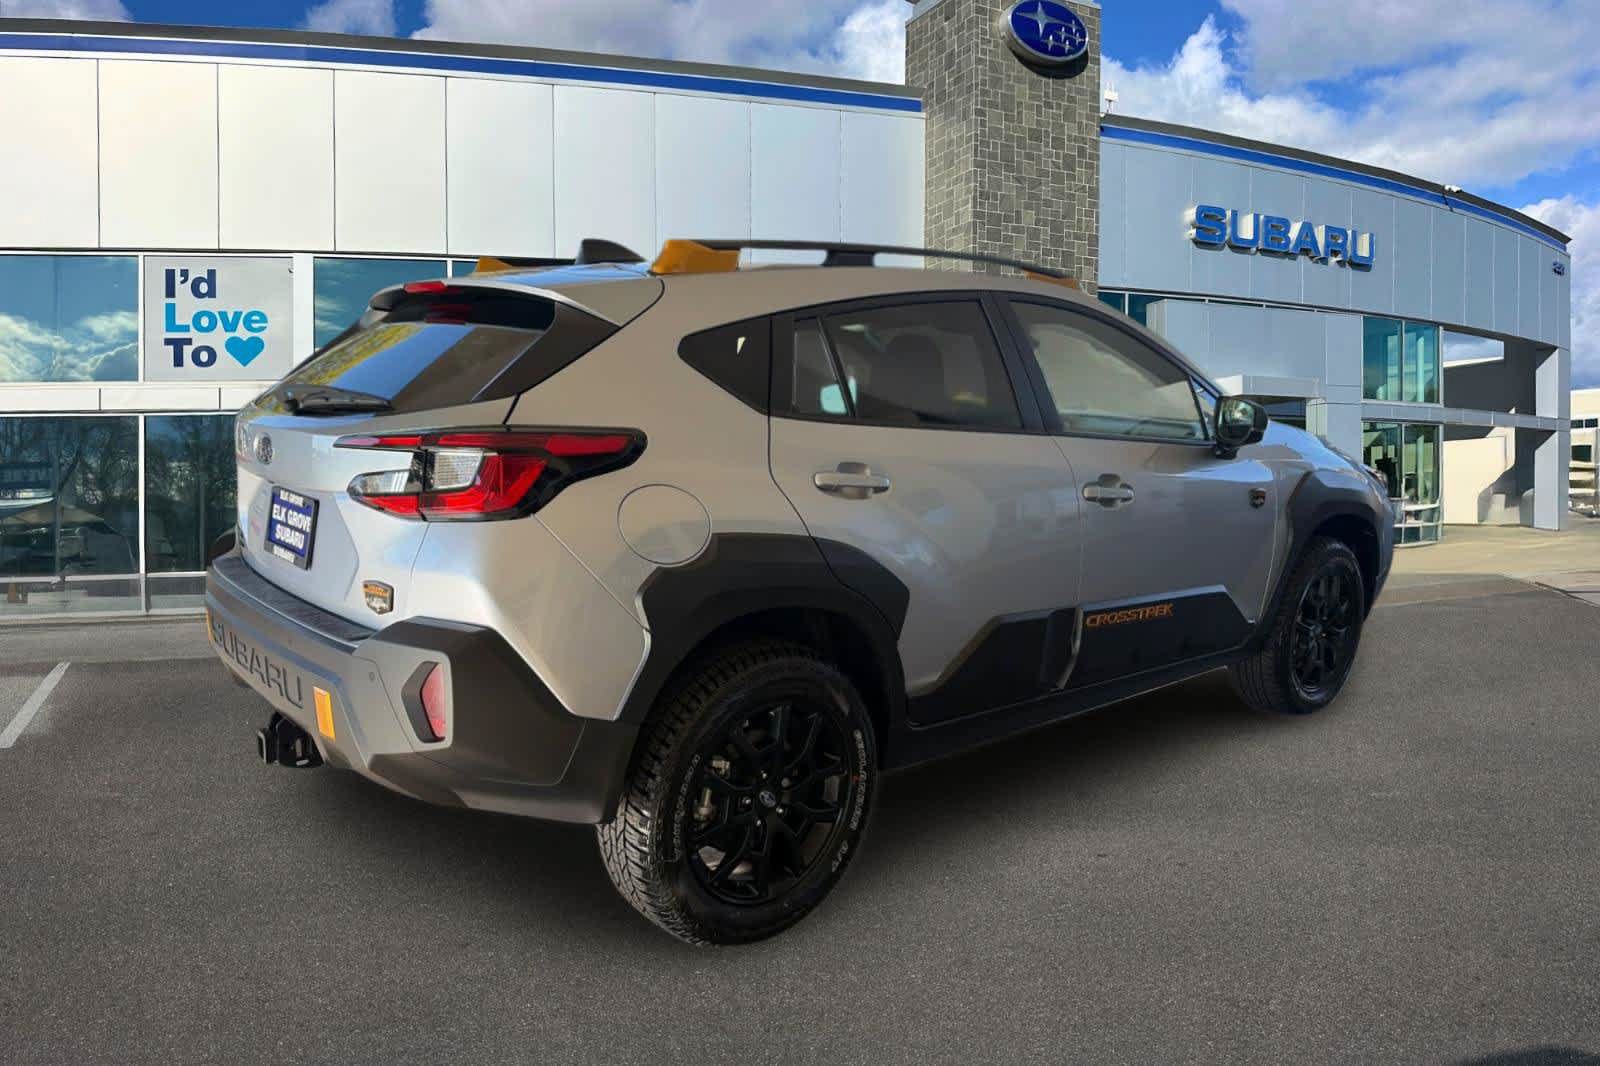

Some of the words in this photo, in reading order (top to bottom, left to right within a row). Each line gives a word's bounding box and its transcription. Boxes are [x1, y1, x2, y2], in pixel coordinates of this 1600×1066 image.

[1191, 204, 1377, 271] SUBARU
[165, 269, 216, 299] I’d
[165, 302, 268, 333] Love
[163, 338, 217, 368] To
[272, 504, 286, 522] ELK
[275, 524, 305, 549] SUBARU
[1086, 602, 1174, 626] CROSSTREK
[211, 621, 303, 709] SUBARU
